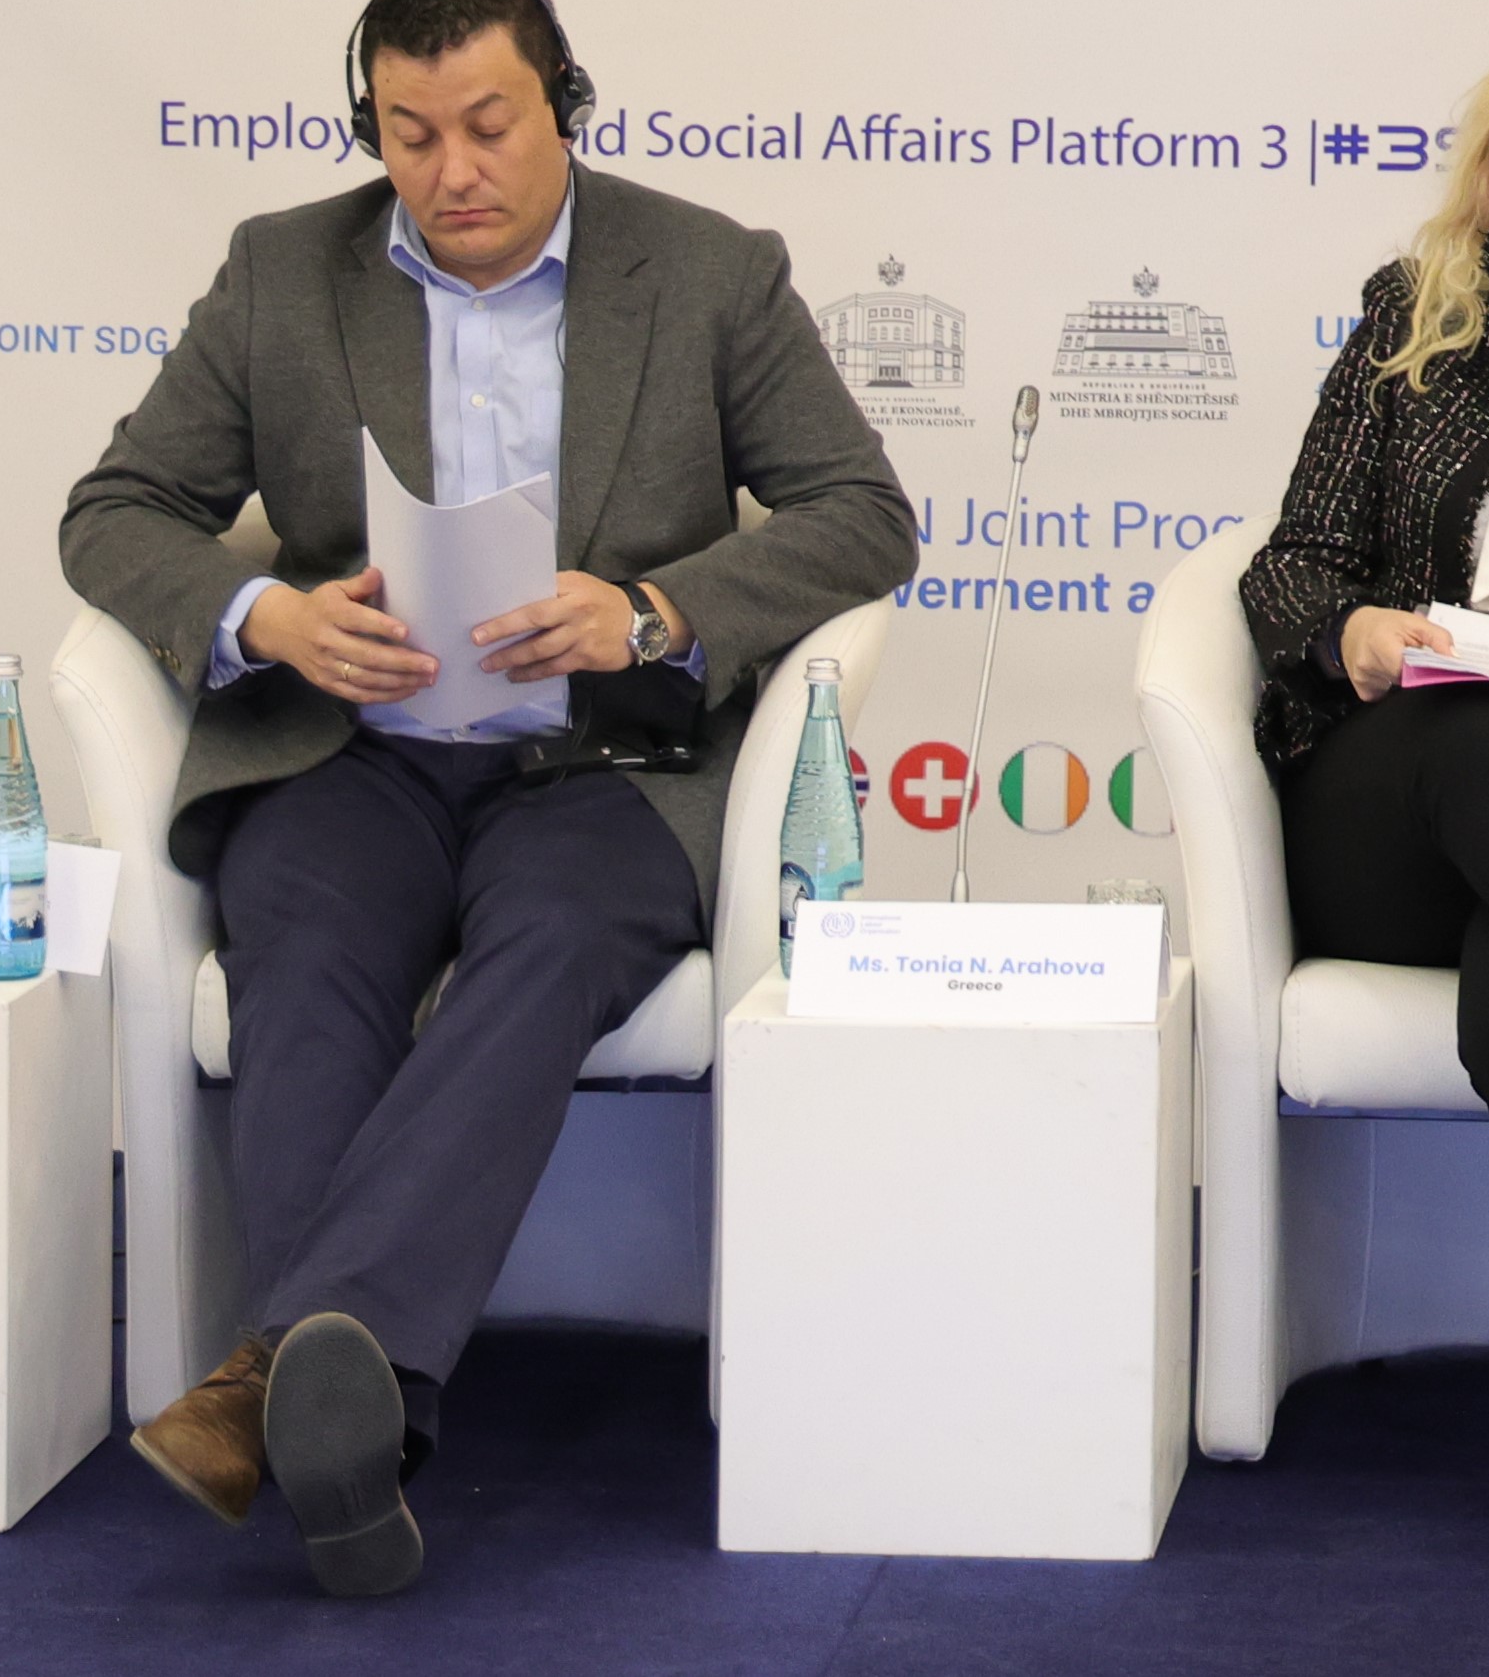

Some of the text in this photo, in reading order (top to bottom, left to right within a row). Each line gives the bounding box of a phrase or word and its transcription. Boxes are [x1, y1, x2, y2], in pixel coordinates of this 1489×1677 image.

[160, 100, 354, 164] Employ
[579, 108, 626, 156] nd
[647, 111, 801, 159] Social
[822, 114, 991, 163] Affairs
[1012, 117, 1239, 167] Platform
[1261, 125, 1287, 169] 3
[95, 326, 168, 355] SDG
[1050, 392, 1120, 403] MINISTRIA
[1125, 393, 1132, 403] E
[897, 418, 976, 428] INOVACIONIT
[1061, 408, 1227, 421] DHE MBROJTJES SOCIALE
[956, 497, 1090, 548] Joint
[894, 573, 1110, 612] verment
[849, 955, 1104, 975] Ms. Tonia N. Arahova
[948, 980, 1002, 991] Greece
